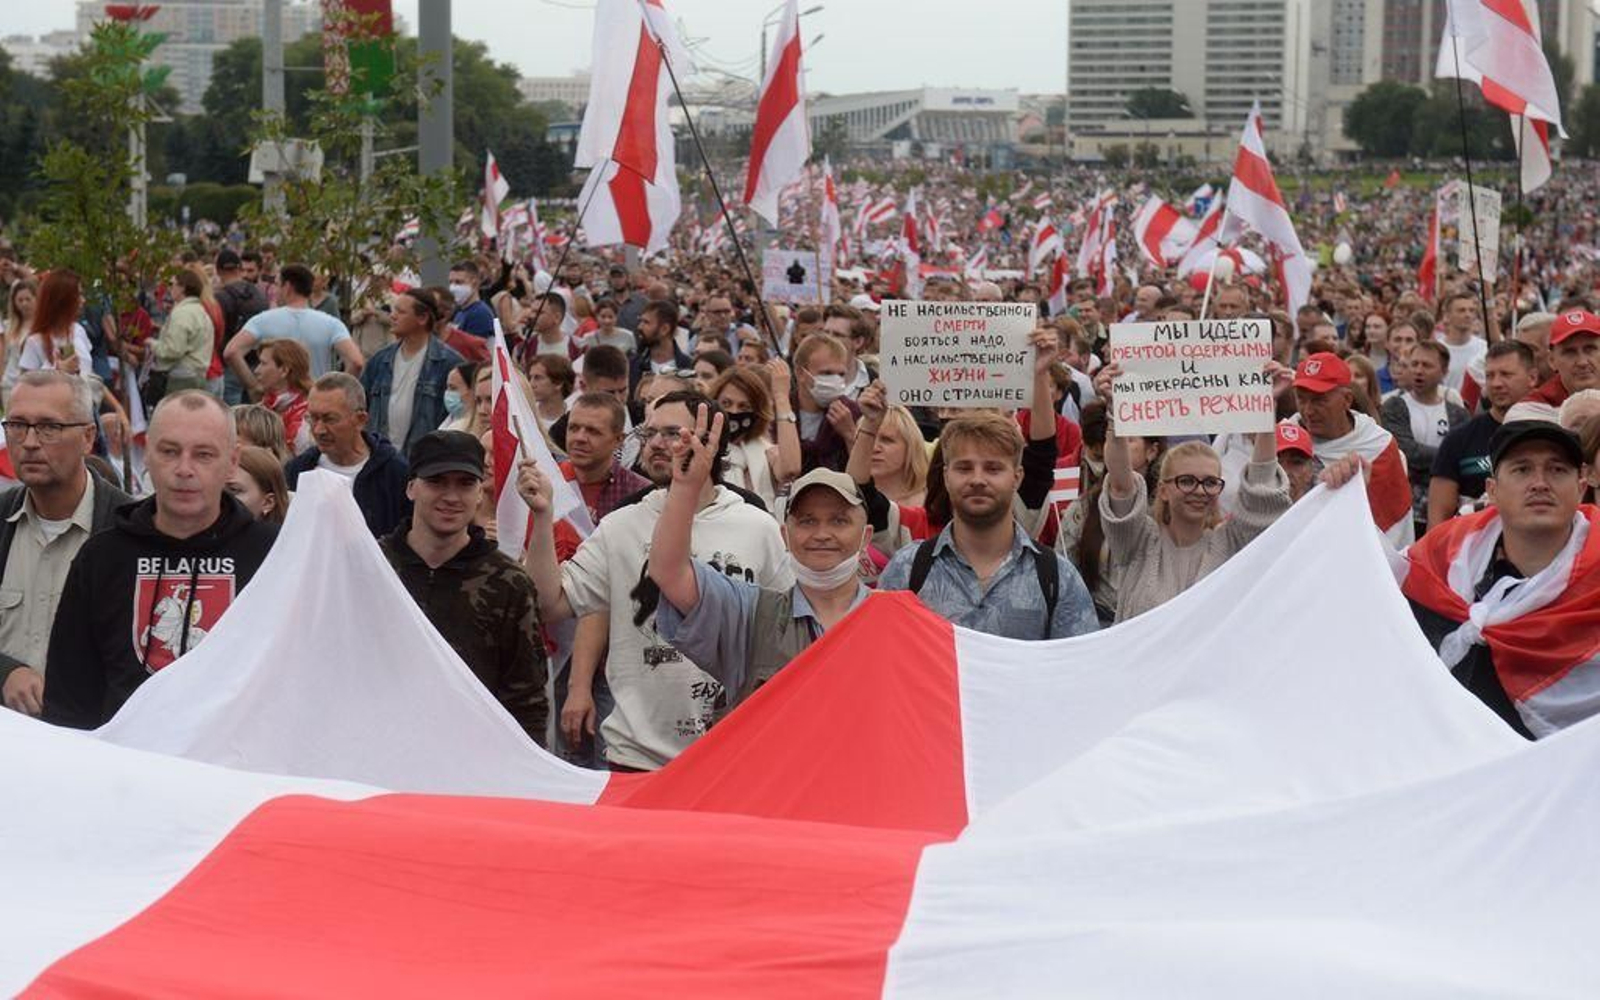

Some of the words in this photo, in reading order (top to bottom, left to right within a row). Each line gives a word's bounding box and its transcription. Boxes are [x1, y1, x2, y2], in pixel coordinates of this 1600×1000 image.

[888, 304, 907, 317] НЕ
[917, 304, 1032, 318] НАСИЛЬСТВЕННОЙ
[934, 319, 987, 333] СМЕРТИ
[1153, 322, 1188, 341] МЫ
[904, 335, 960, 348] БОЯТЬСЯ
[1112, 343, 1175, 359] МЕЧТОЙ
[1181, 343, 1272, 358] ОДЕРЖИМЫ
[891, 356, 898, 367] А
[1181, 360, 1199, 374] И
[928, 367, 987, 384] ЖИЗНИ
[1113, 381, 1135, 393] МЫ
[1139, 374, 1229, 392] ПРЕКРАСНЫ
[1238, 372, 1272, 386] КАК
[899, 389, 933, 403] ОНО
[943, 388, 1025, 401] СТРАШНЕЕ
[1119, 397, 1190, 422] СМЕРТЬ
[137, 557, 235, 574] BELARUS
